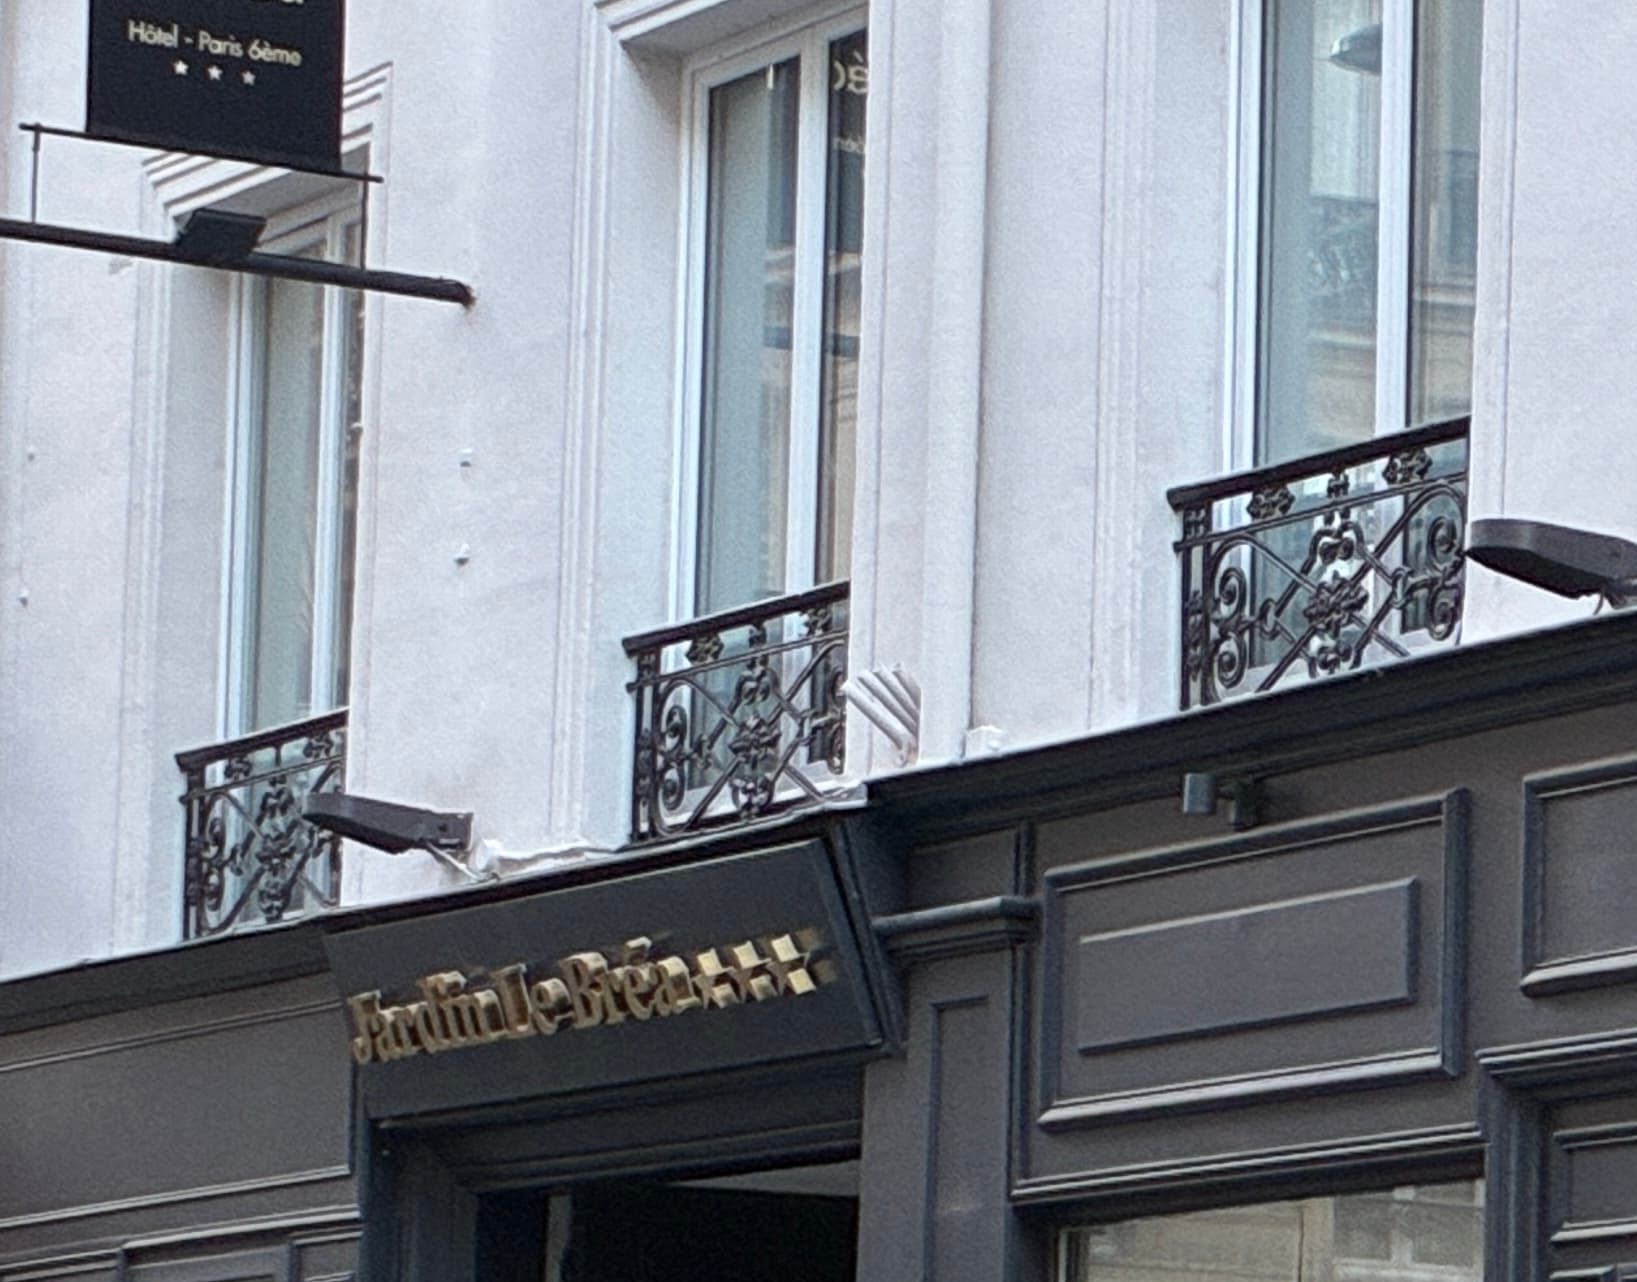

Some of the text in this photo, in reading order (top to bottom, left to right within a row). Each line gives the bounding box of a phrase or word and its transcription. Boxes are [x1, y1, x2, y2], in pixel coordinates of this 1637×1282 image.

[127, 19, 178, 48] Hôtel
[198, 30, 244, 58] Paris
[248, 39, 303, 67] 6ème
[347, 971, 503, 1065] Jardin
